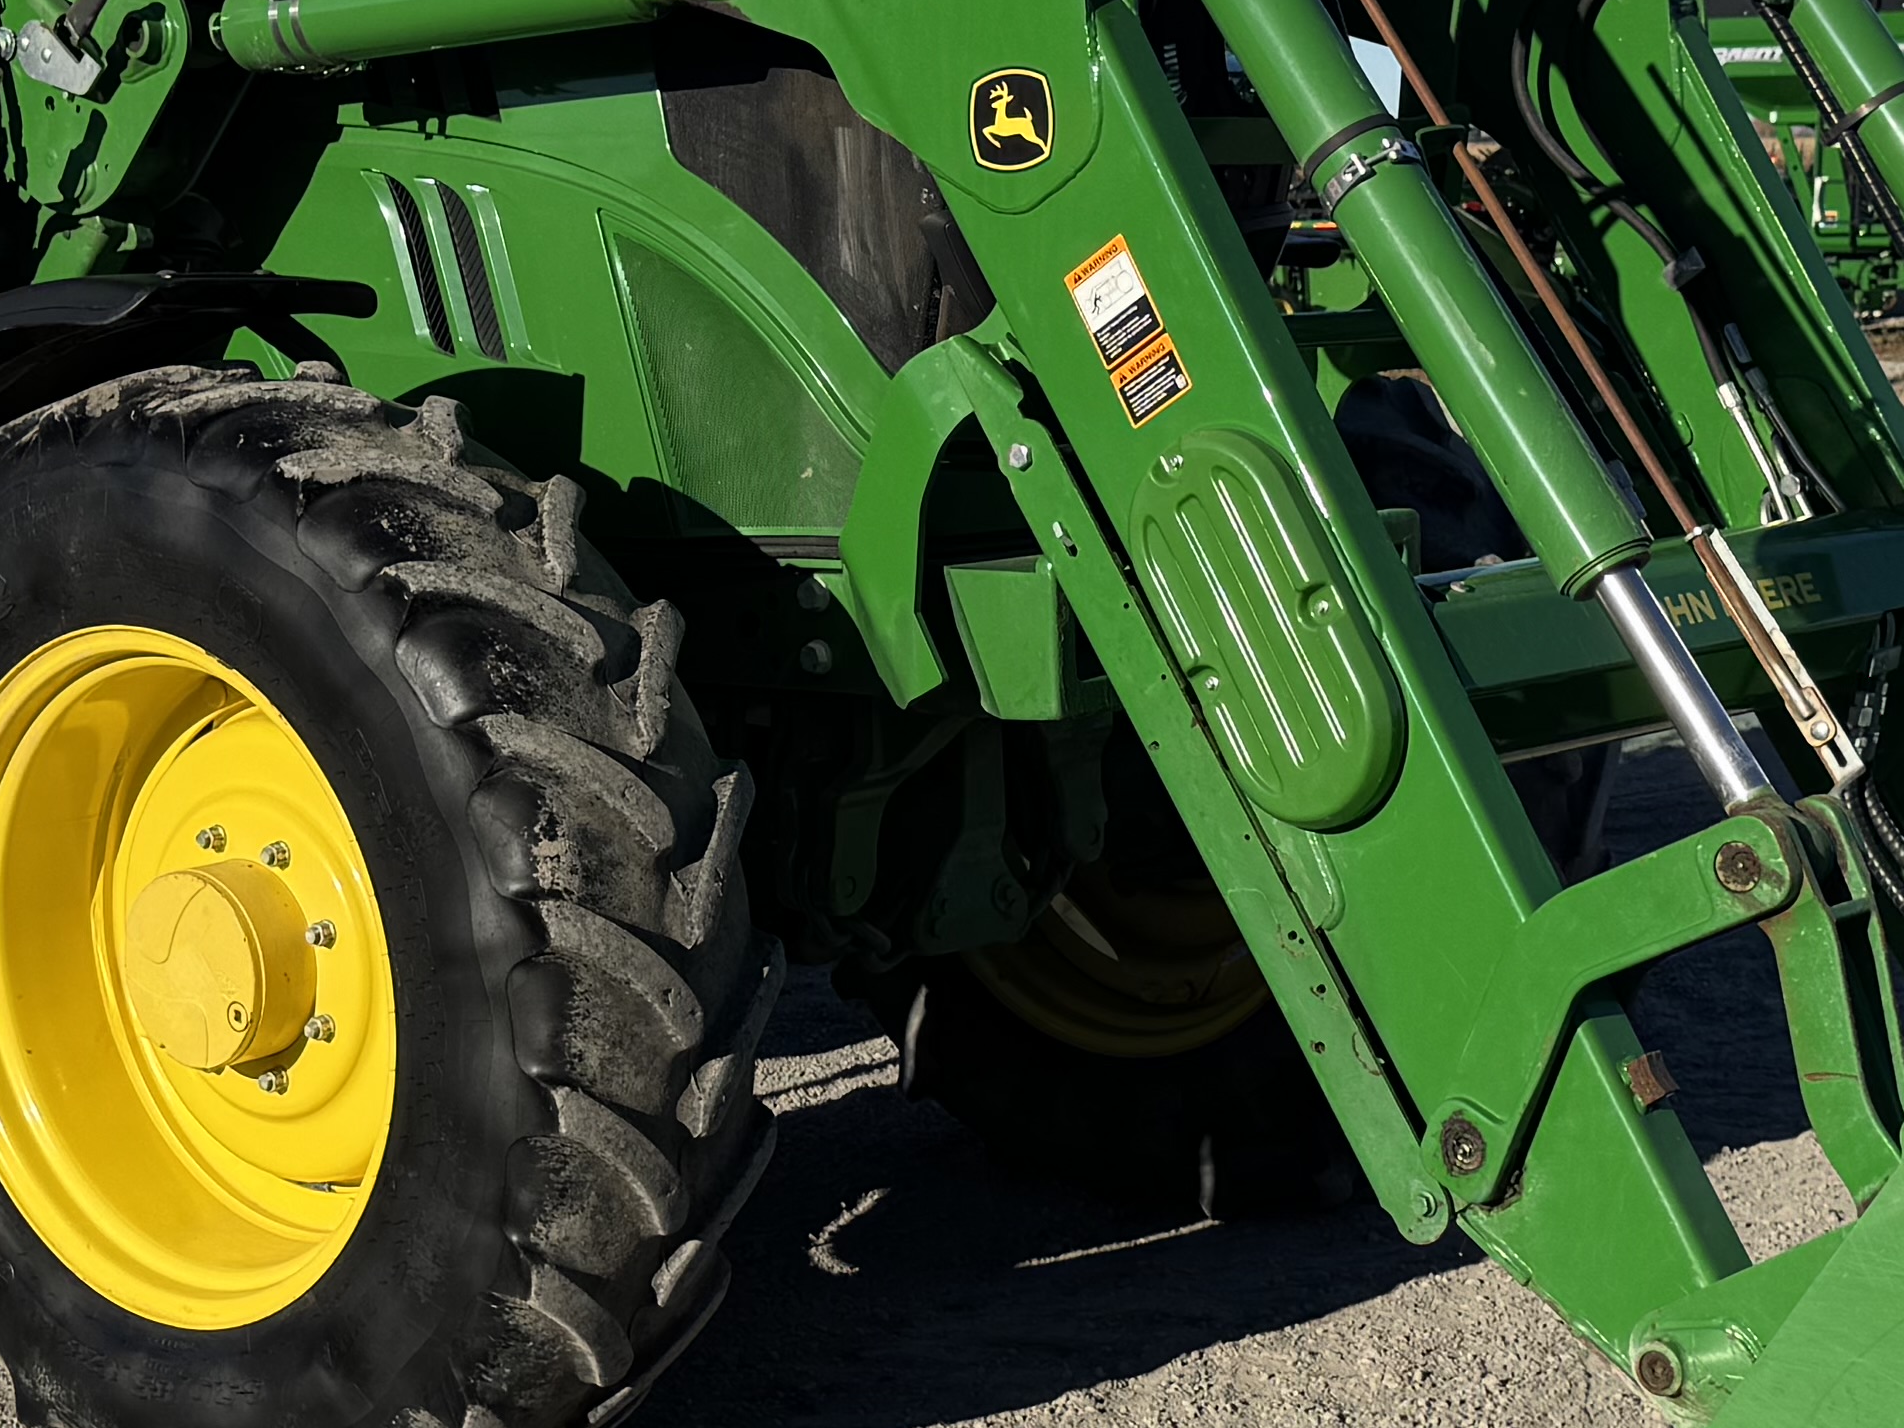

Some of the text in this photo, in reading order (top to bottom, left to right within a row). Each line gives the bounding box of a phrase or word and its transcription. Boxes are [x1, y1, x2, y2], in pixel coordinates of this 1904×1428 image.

[1081, 243, 1119, 278] WARNING
[1127, 342, 1166, 375] WARNING
[1663, 589, 1717, 628] HN
